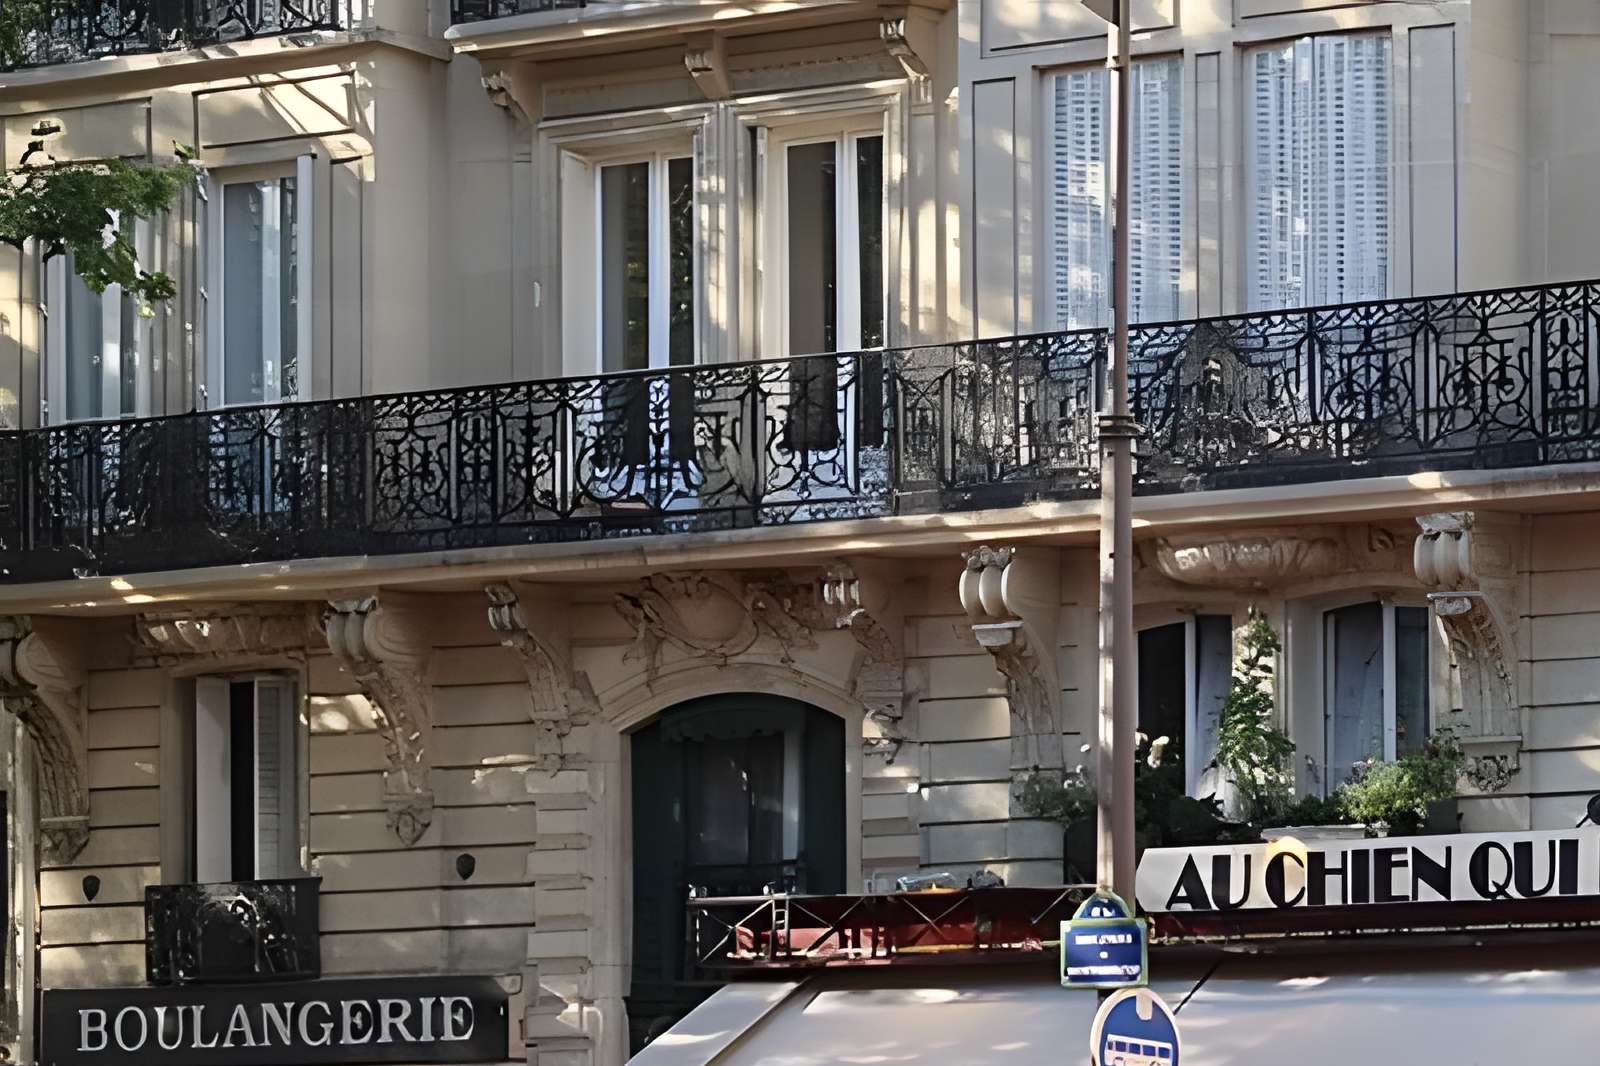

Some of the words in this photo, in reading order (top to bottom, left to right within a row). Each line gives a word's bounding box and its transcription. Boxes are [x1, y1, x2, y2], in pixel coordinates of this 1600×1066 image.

[1165, 851, 1252, 911] AU
[1265, 845, 1452, 908] CHIEN
[1468, 837, 1579, 900] QUI
[76, 996, 476, 1052] BOULANGERIE
